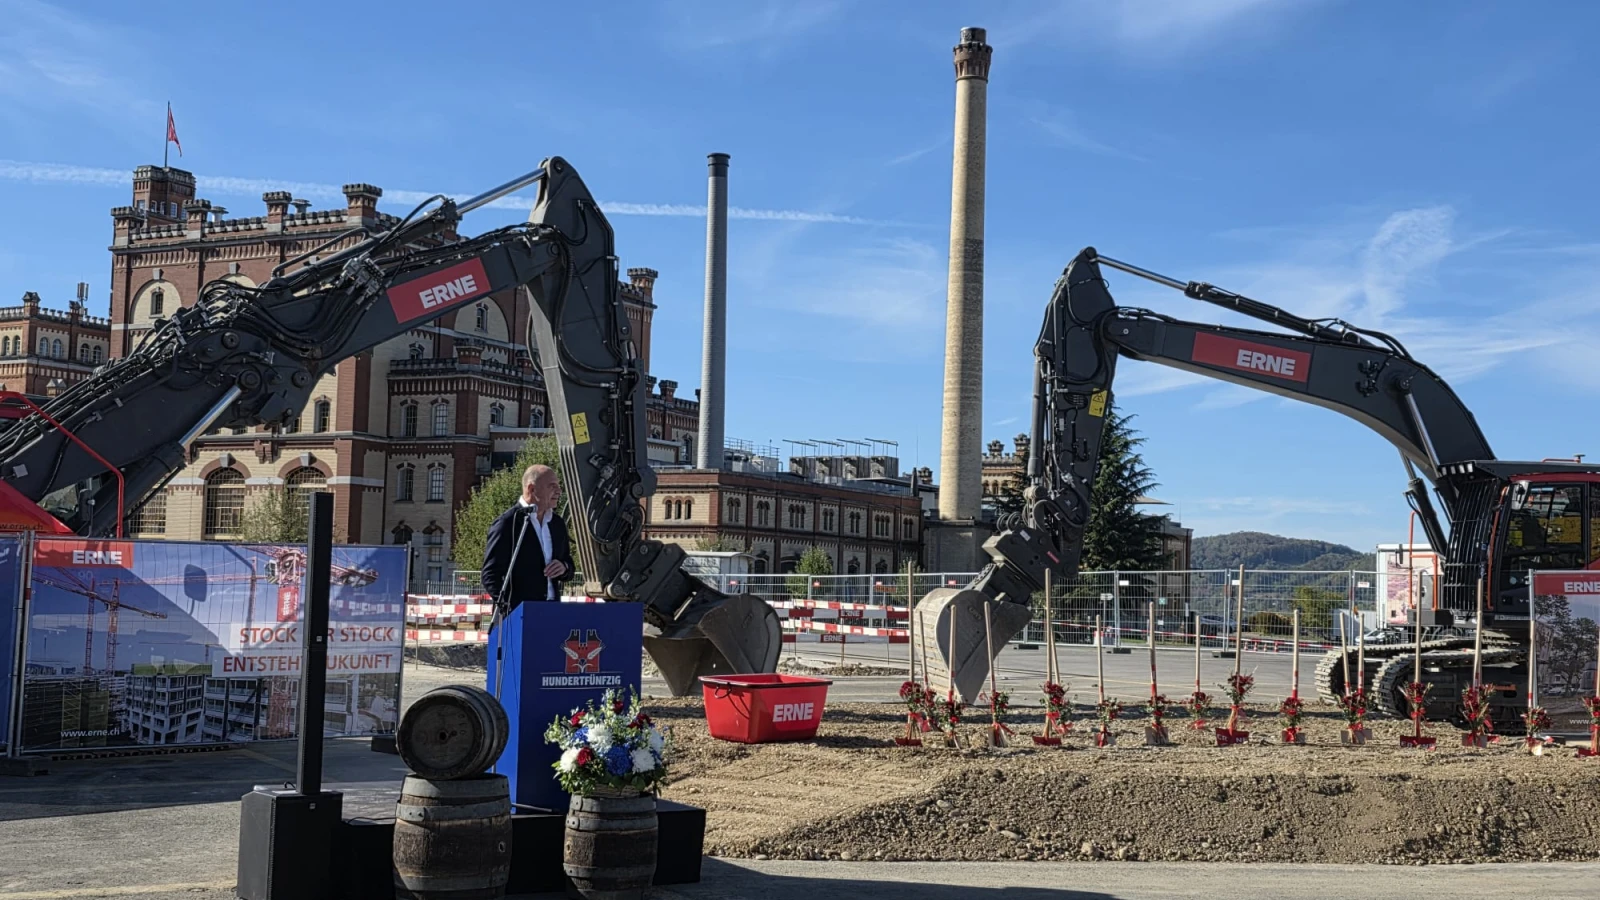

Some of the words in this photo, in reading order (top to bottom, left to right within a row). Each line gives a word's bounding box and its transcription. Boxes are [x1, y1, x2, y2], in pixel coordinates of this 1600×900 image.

[419, 274, 478, 309] ERNE
[1236, 349, 1296, 376] ERNE
[72, 549, 122, 565] ERNE
[1563, 581, 1600, 593] ERNE
[240, 627, 298, 643] STOCK
[340, 626, 394, 642] STOCK
[223, 655, 304, 672] ENTSTEH
[326, 654, 393, 670] UKUNFT
[542, 674, 621, 686] HUNDERTFÜNFZIG
[773, 703, 814, 722] ERNE
[60, 727, 120, 737] www.erne.ch
